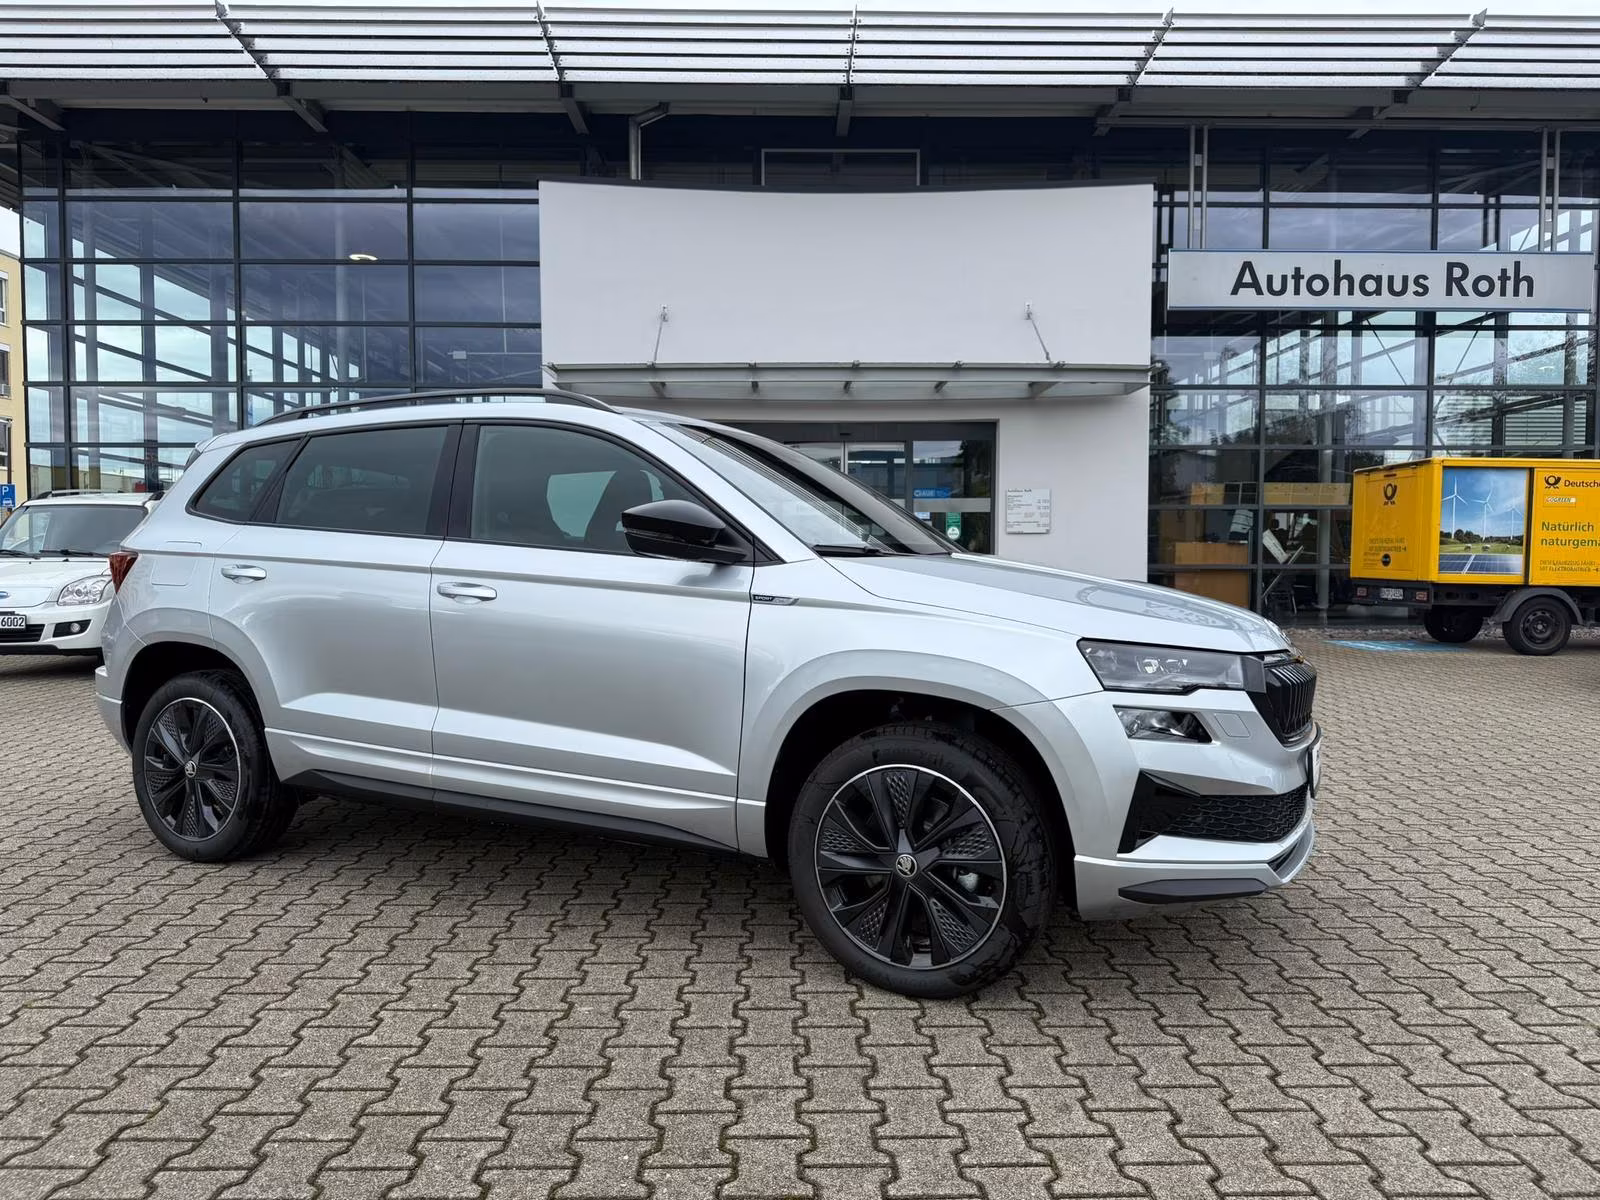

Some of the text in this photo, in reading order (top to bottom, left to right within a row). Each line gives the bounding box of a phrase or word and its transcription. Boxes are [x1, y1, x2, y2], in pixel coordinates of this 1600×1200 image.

[1230, 259, 1535, 298] Autohaus Roth
[1564, 479, 1600, 488] Deutsch
[2, 485, 9, 496] P
[1541, 521, 1595, 532] Natürlich
[1, 616, 25, 627] 6002
